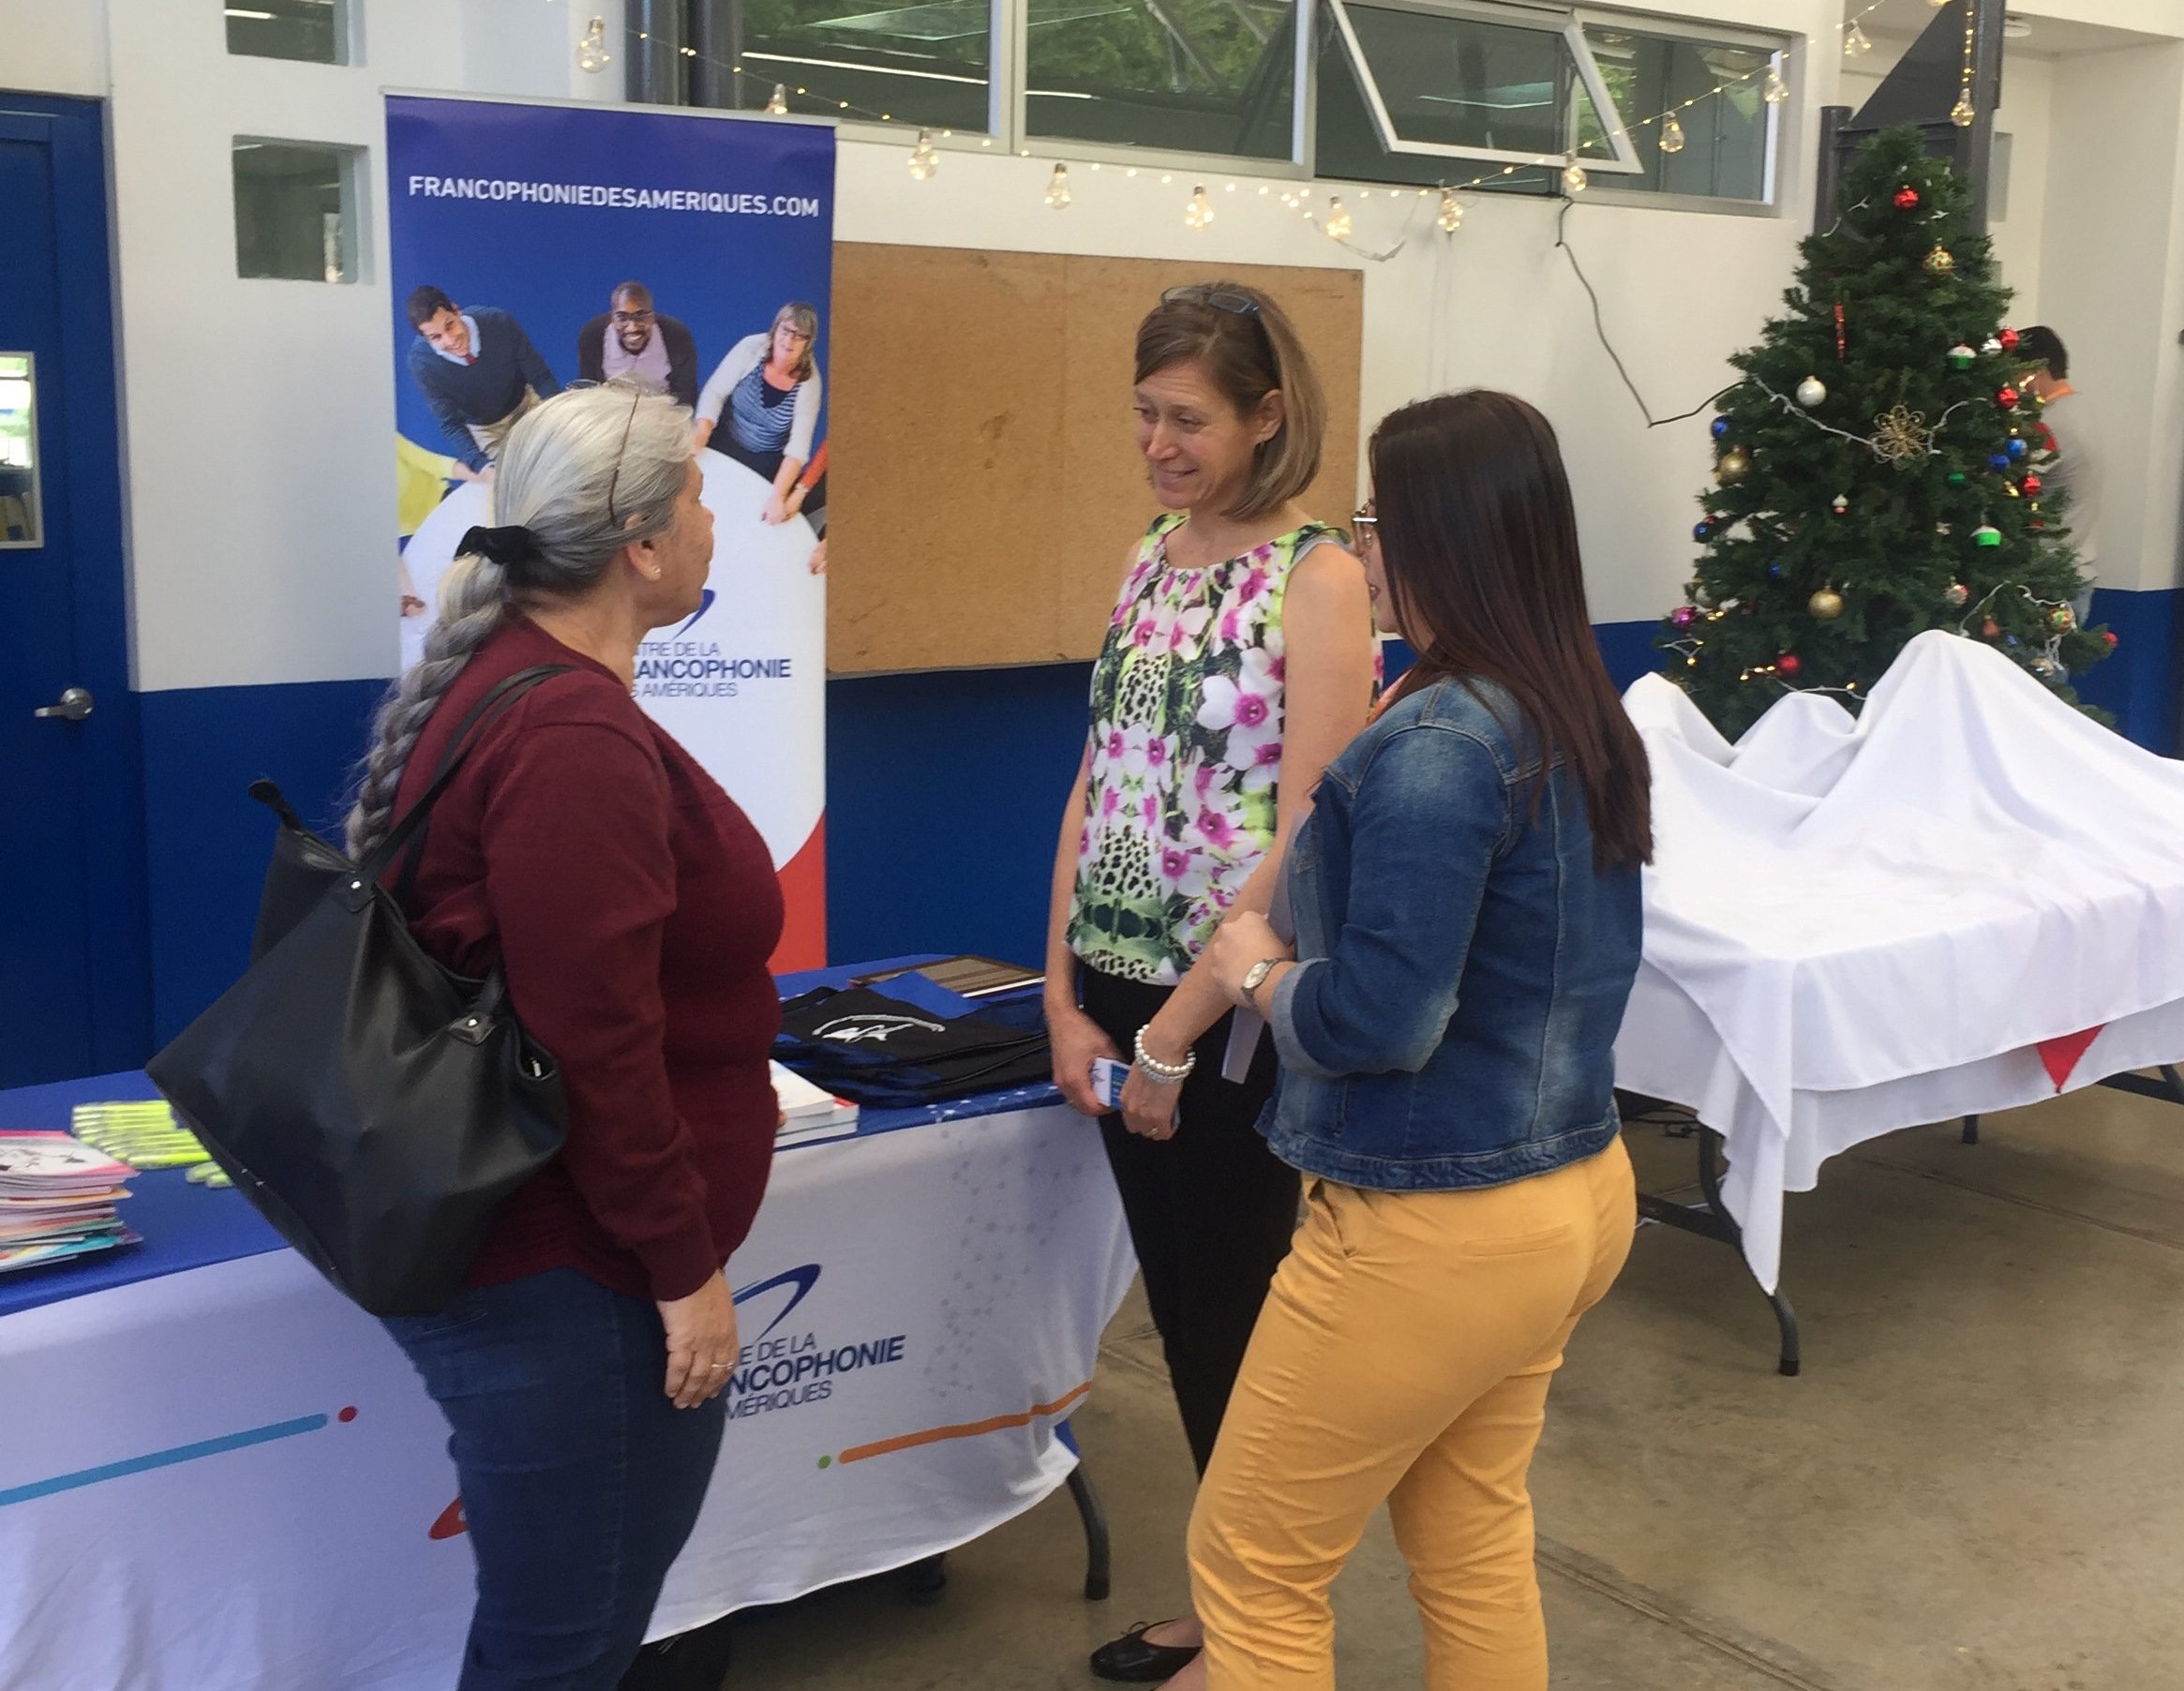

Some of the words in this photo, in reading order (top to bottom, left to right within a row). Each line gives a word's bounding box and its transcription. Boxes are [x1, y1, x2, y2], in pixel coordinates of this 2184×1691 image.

[409, 175, 819, 217] FRANCOPHONIEDESAMERIQUES.COM
[636, 642, 671, 656] TRE
[675, 642, 696, 656] DE
[699, 642, 720, 656] LA
[635, 659, 791, 679] ANCOPHONIE
[641, 681, 738, 697] AMÉRIQUES
[757, 1338, 787, 1361] DE
[790, 1332, 818, 1354] LA
[730, 1335, 906, 1395] NCOPHONIE
[726, 1380, 832, 1420] MÉRIQUES
